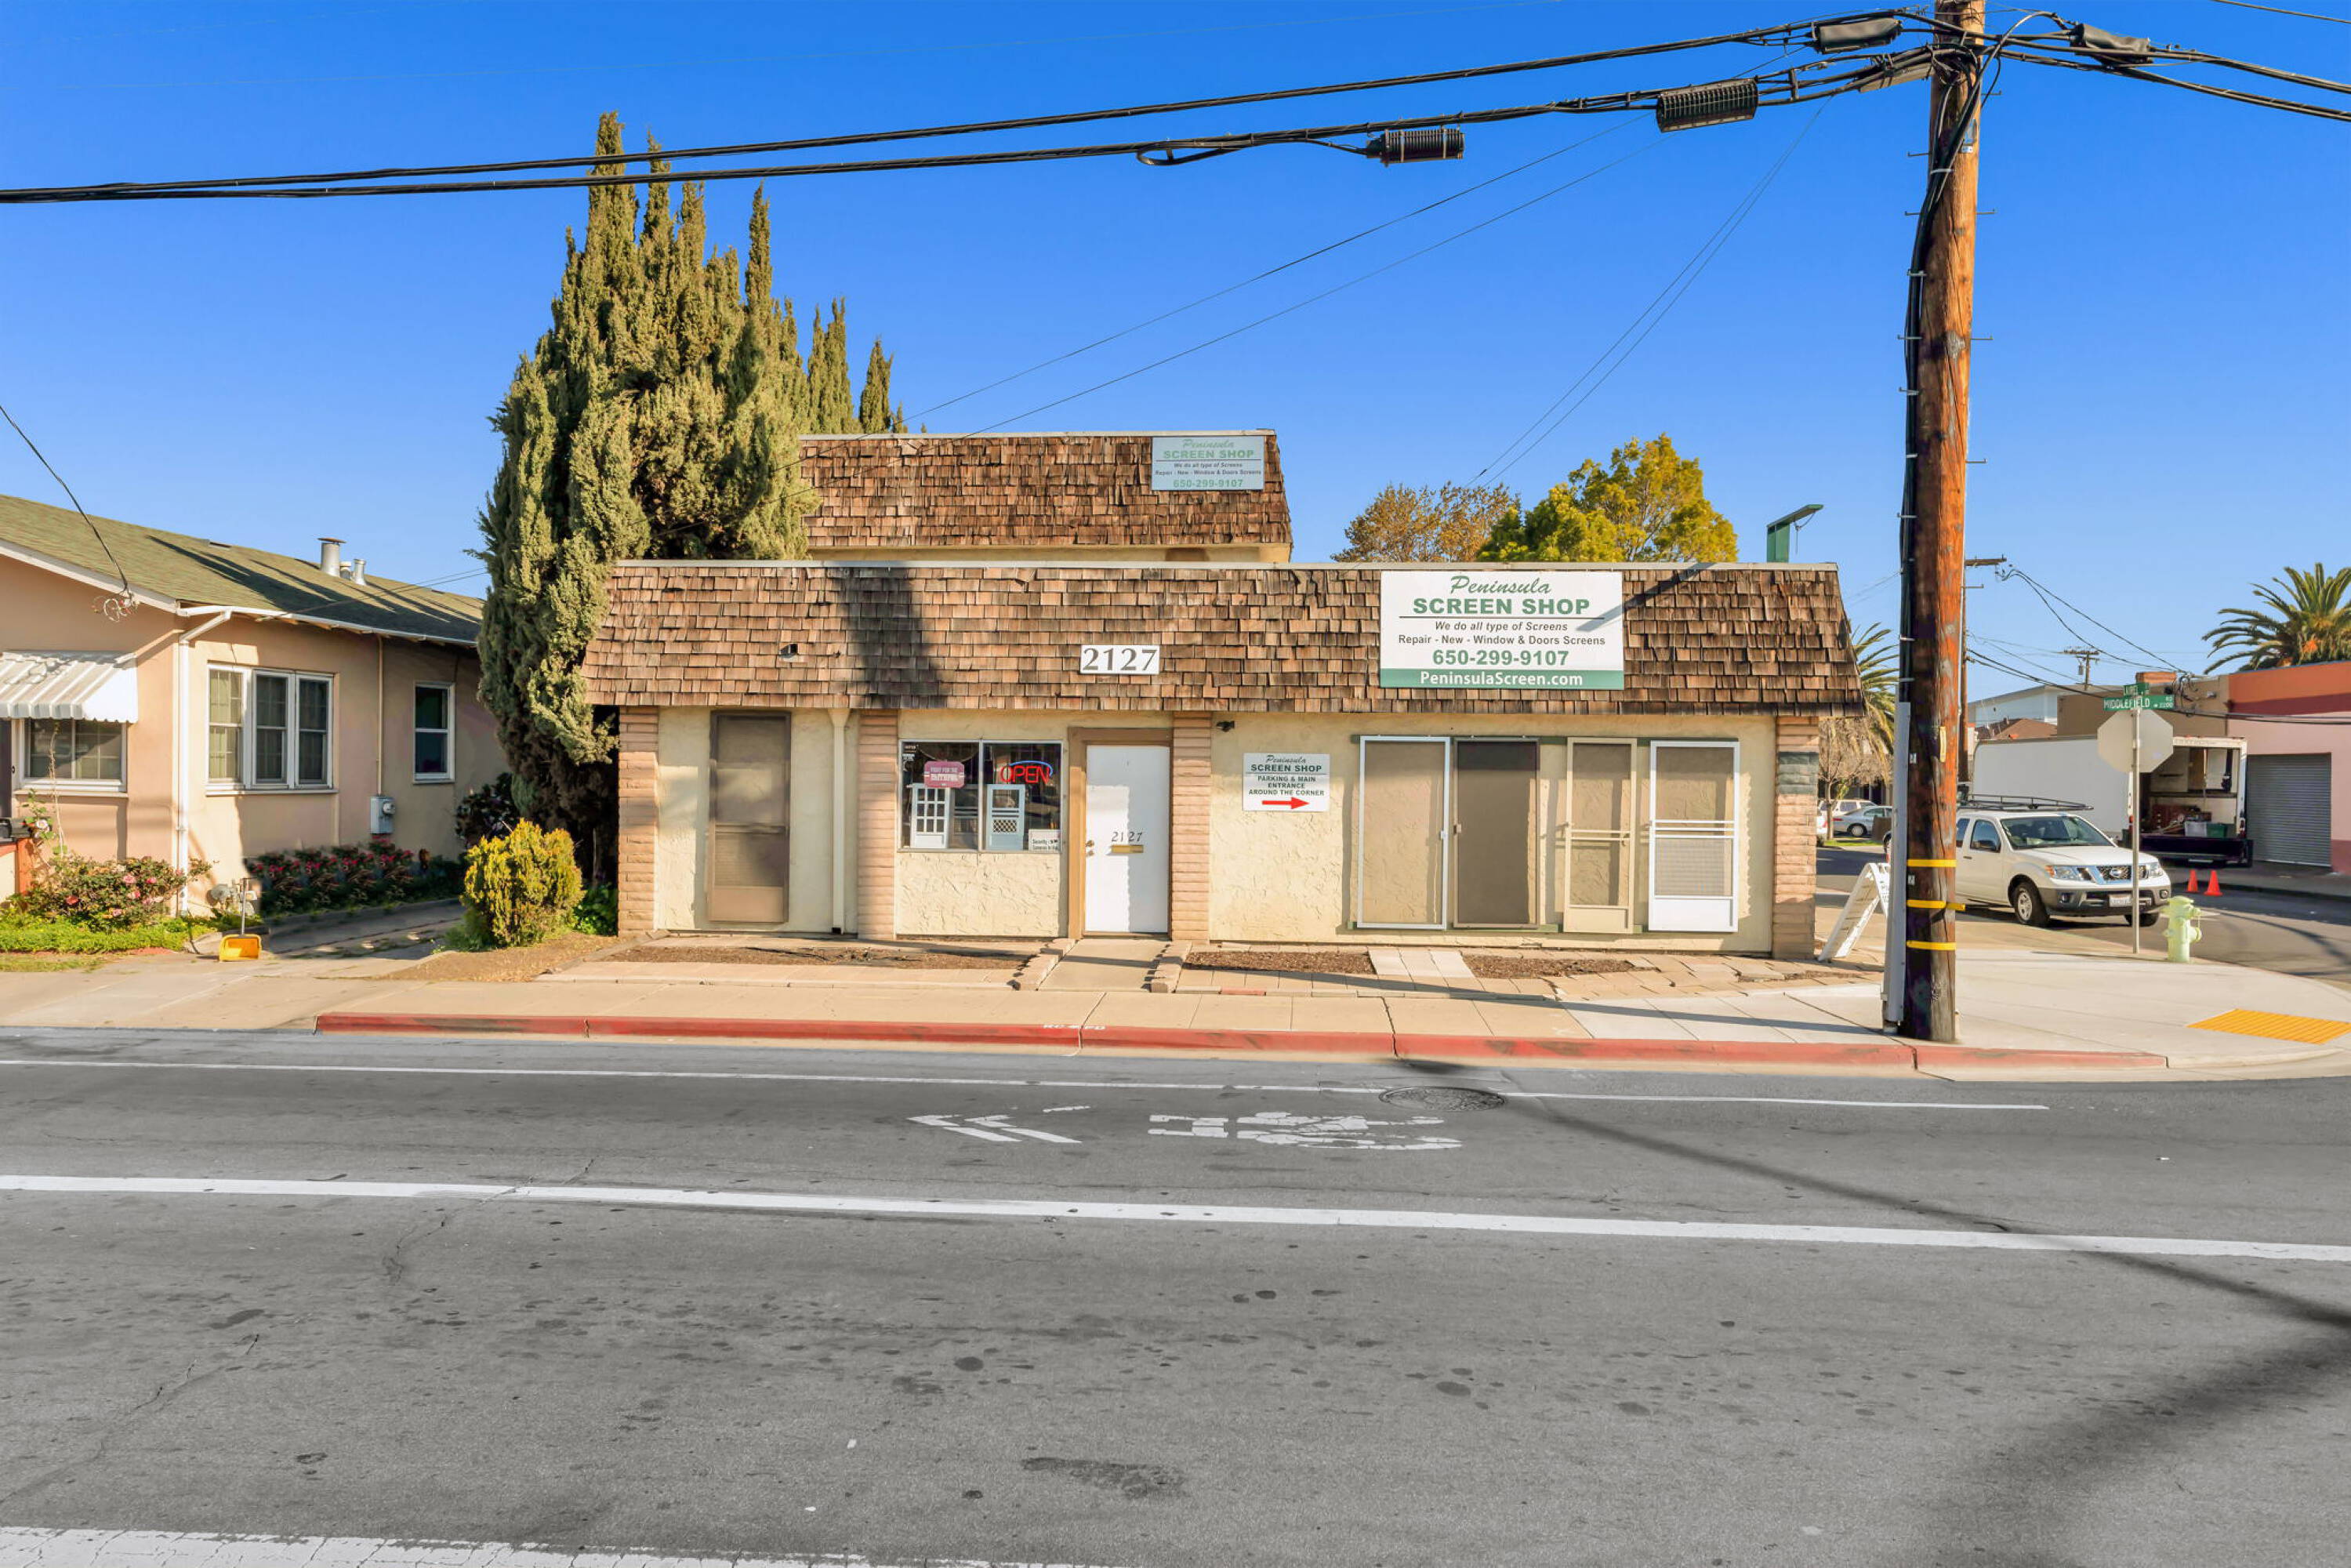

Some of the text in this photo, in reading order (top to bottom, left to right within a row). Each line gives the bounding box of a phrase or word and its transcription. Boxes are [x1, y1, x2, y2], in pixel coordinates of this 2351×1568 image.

[1163, 449, 1254, 459] SCREEN SHOP
[1173, 479, 1243, 488] 650-299-9107
[1450, 575, 1551, 594] Peninsula
[1413, 597, 1590, 615] SCREEN SHOP
[1435, 621, 1568, 633] We do all type of Screens
[1399, 634, 1431, 645] Repair
[1442, 635, 1464, 644] New
[1474, 635, 1515, 644] Window
[1518, 635, 1526, 644] &
[1529, 636, 1560, 644] Doors
[1563, 636, 1605, 645] Screens
[1083, 648, 1157, 671] 2127
[1433, 649, 1569, 666] 650-299-9107
[1420, 671, 1583, 685] PeninsulaScreen.com
[1000, 765, 1050, 785] OPEN
[1111, 831, 1143, 842] 2127
